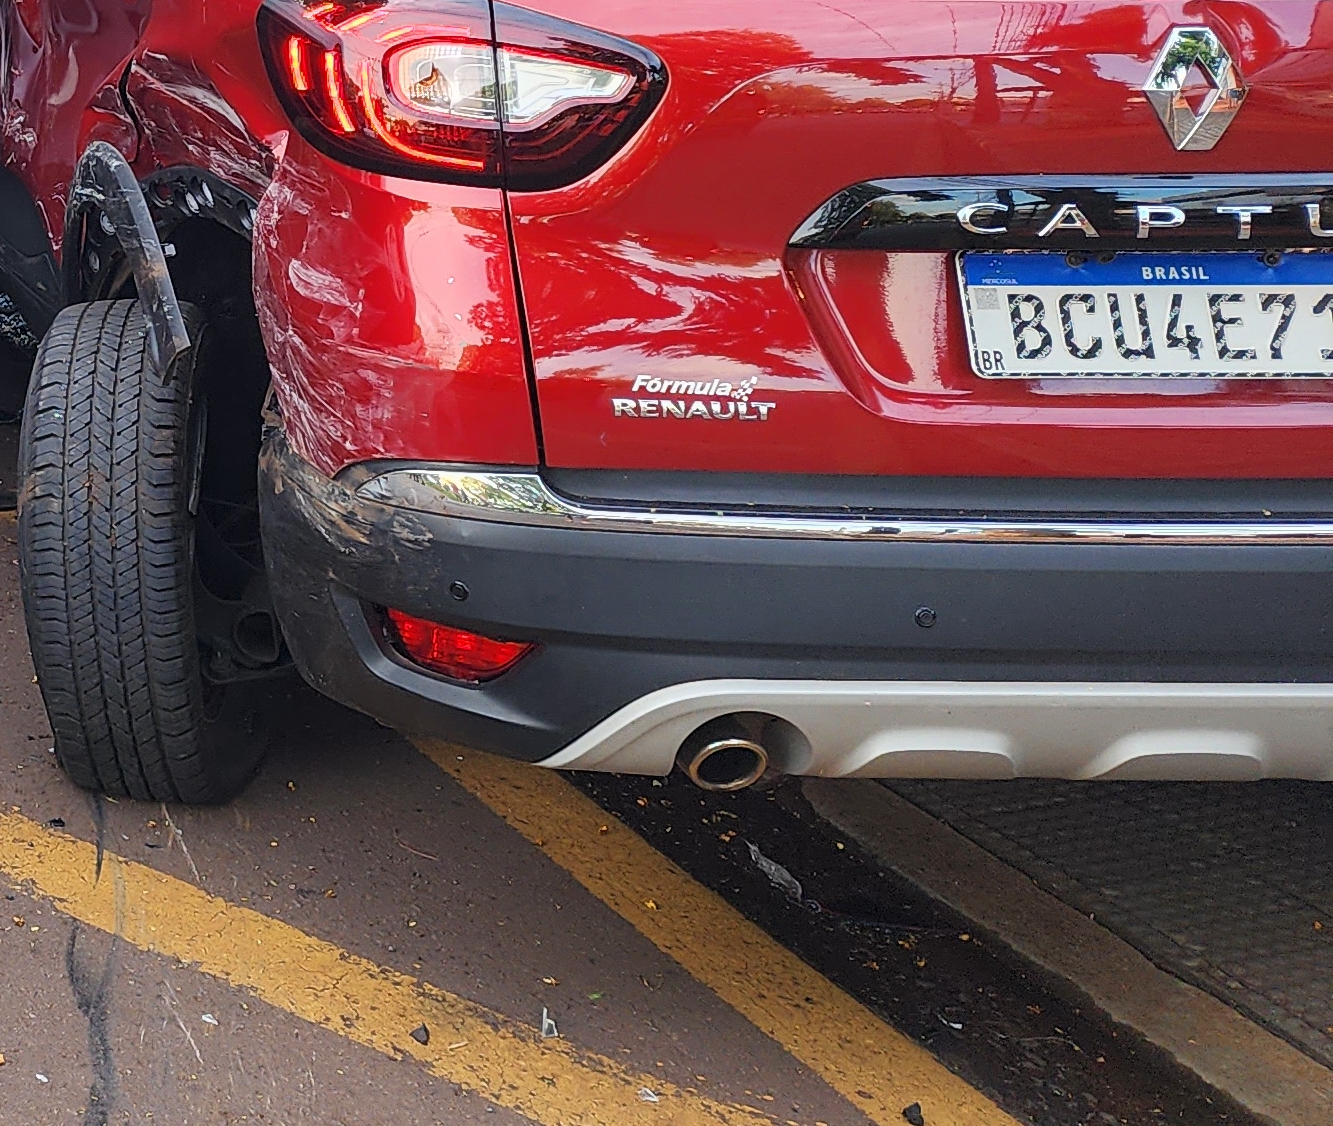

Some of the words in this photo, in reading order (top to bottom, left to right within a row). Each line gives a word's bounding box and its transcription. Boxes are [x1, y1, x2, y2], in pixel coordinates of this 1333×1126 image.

[1141, 266, 1210, 280] BRASIL
[982, 351, 1005, 371] BR
[632, 374, 733, 397] Fórmula
[612, 398, 776, 421] RENAULT
